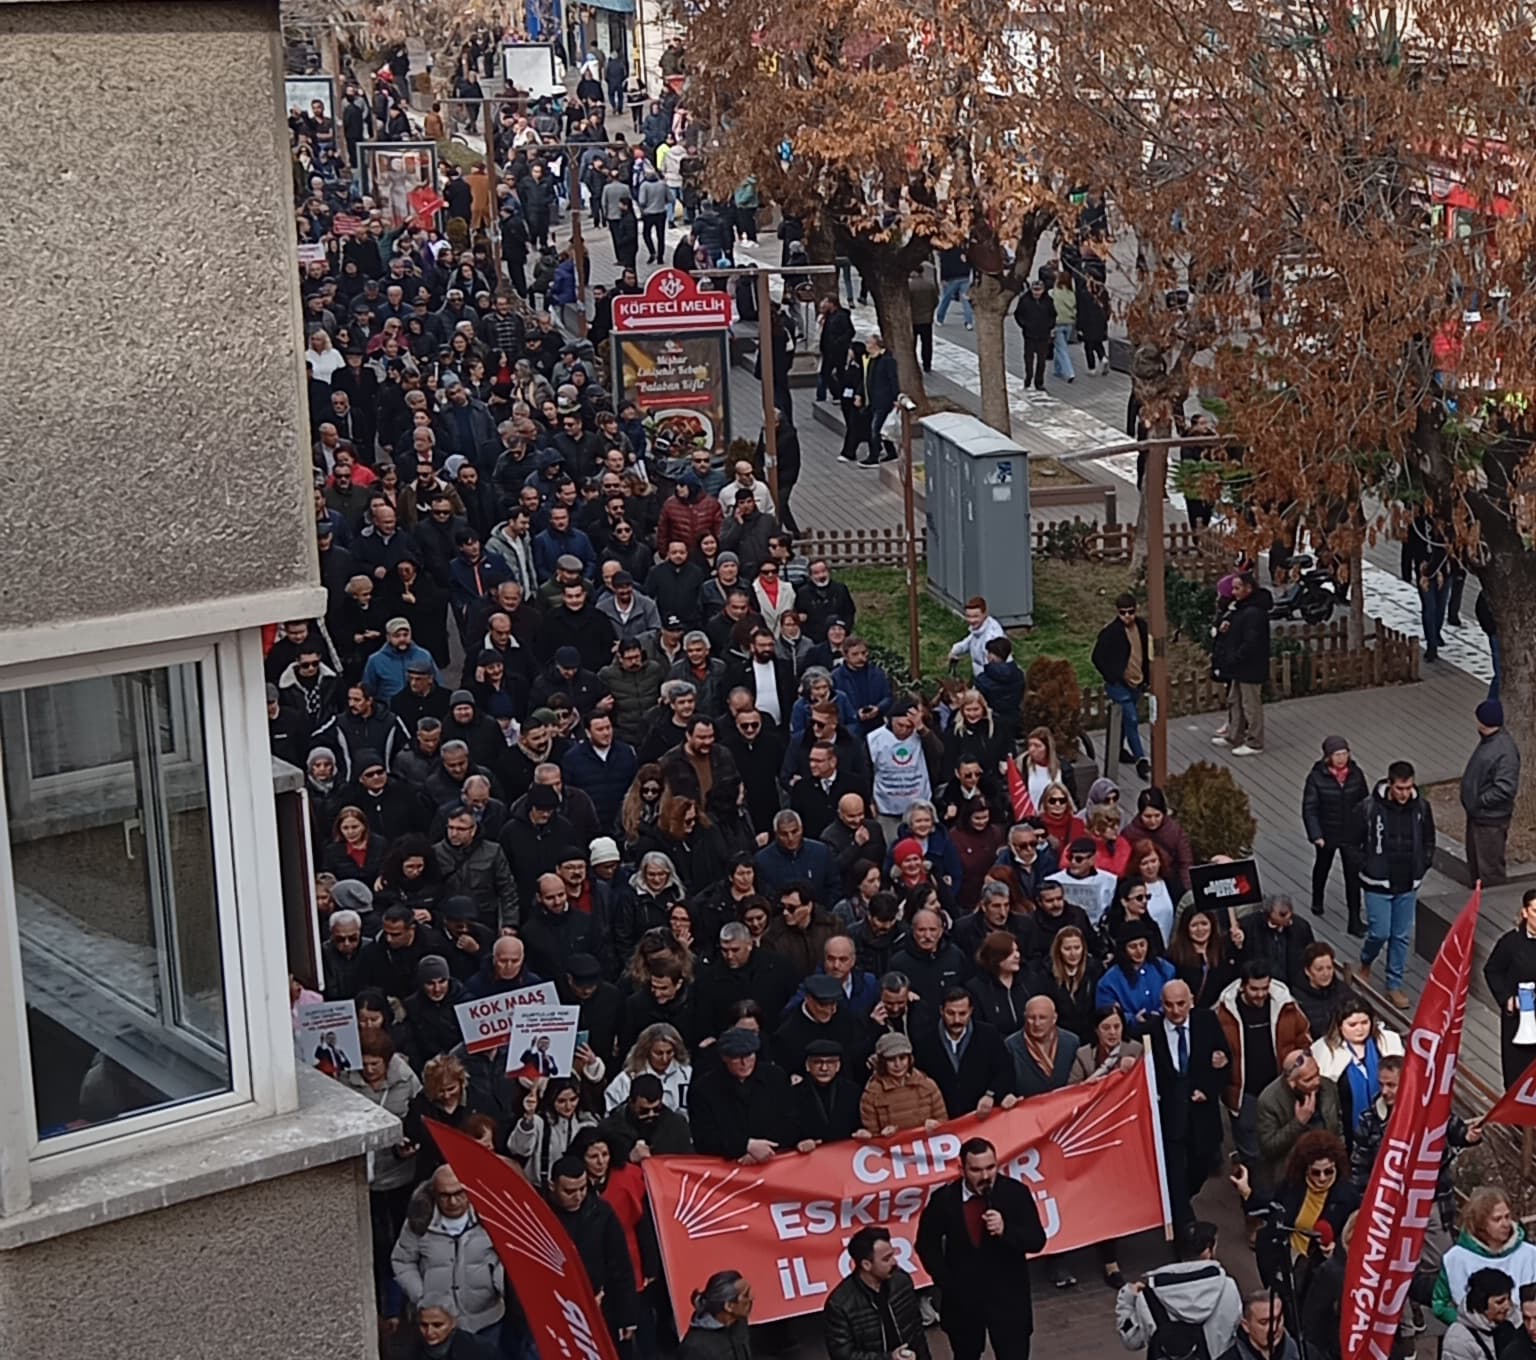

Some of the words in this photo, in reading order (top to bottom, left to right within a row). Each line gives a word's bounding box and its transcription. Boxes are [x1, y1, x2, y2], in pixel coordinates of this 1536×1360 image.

[619, 300, 678, 316] KÖFTECİ
[680, 298, 725, 313] MELİH
[504, 989, 546, 1010] MAAŞ
[851, 1133, 964, 1185] CHP
[776, 1255, 828, 1301] İL
